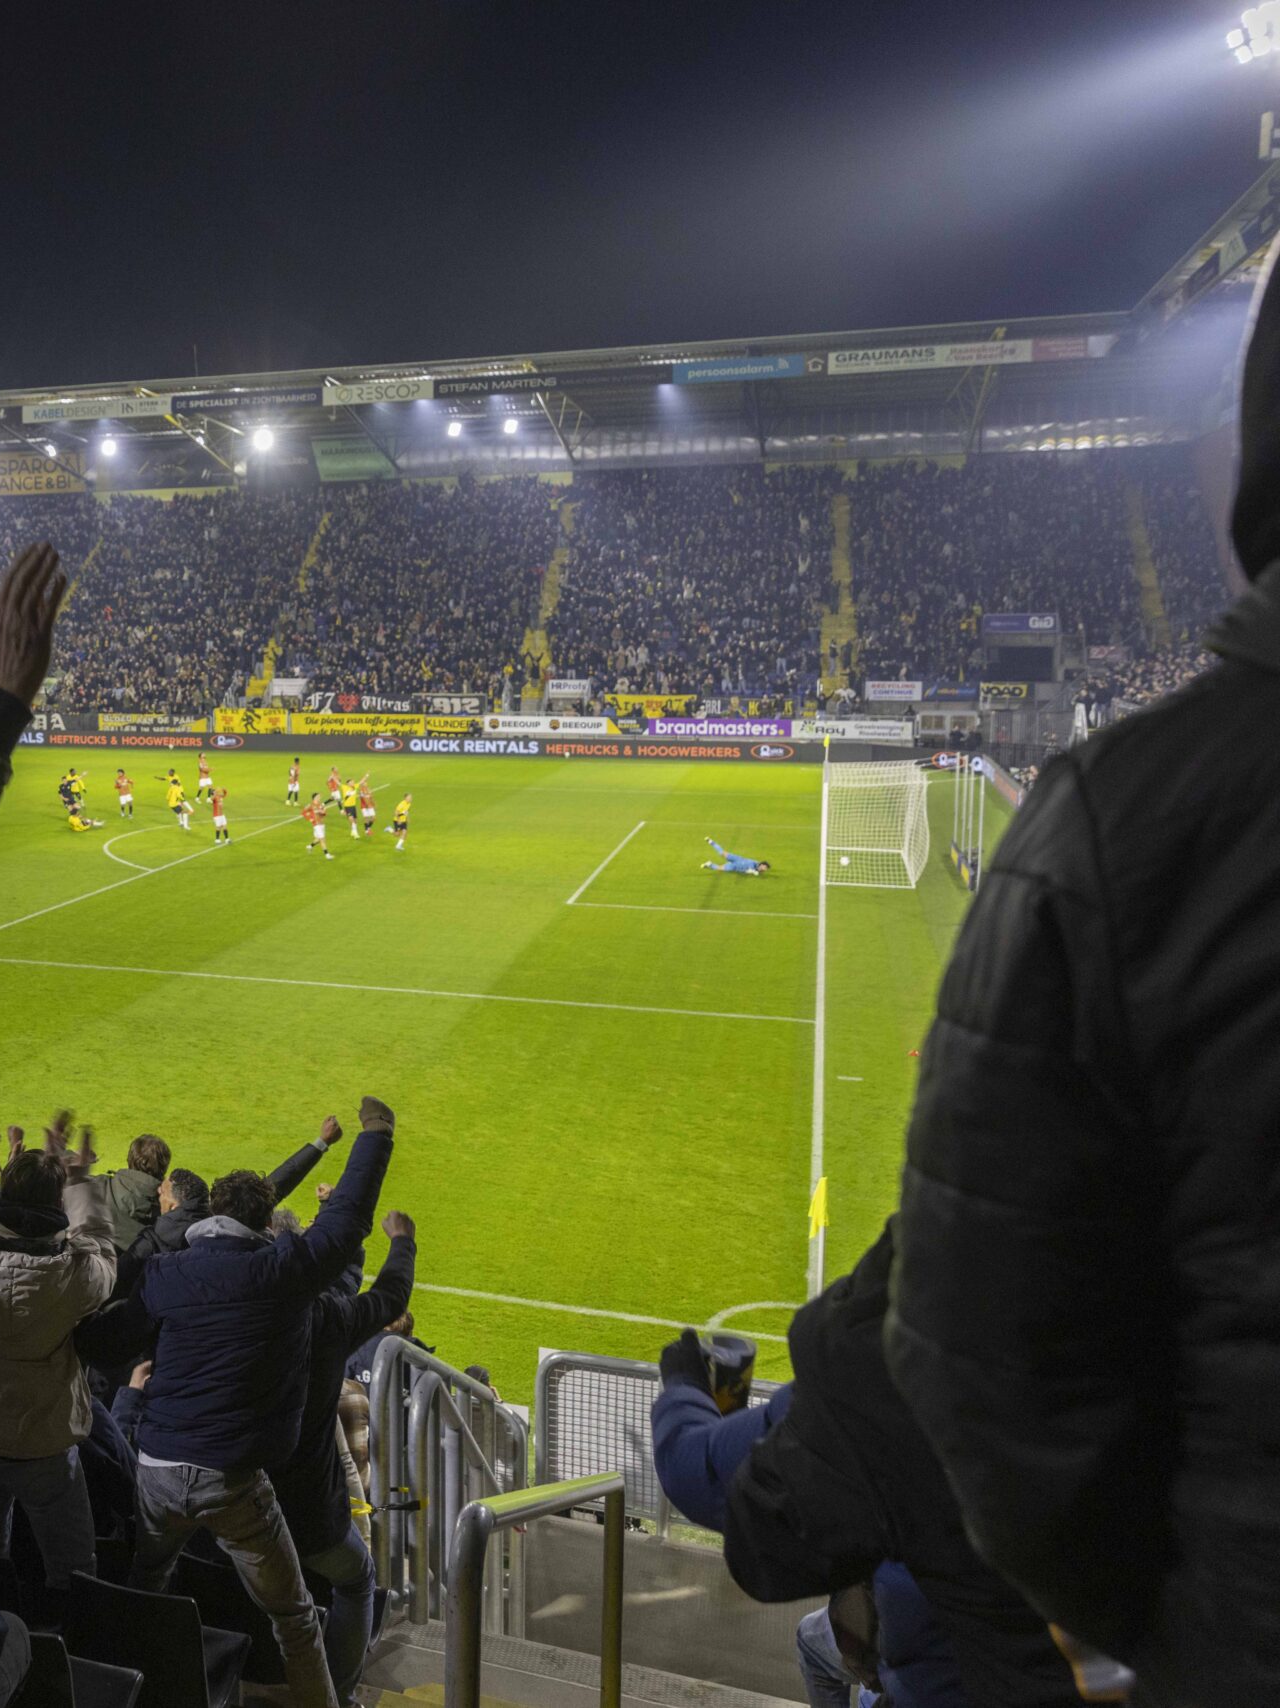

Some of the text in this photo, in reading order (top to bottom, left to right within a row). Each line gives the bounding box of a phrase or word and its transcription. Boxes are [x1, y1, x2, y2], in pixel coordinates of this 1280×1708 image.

[835, 347, 936, 363] GRAUMANS
[356, 383, 421, 401] RESCOP
[439, 382, 489, 394] STEFAN
[491, 376, 557, 391] MARTENS
[189, 398, 238, 409] SPECIALIST
[251, 392, 317, 405] ZICHTBAARHEID
[32, 404, 106, 419] KABELDESIGN
[361, 695, 411, 711] Ultras
[501, 720, 541, 728] BEEQUIP
[561, 721, 603, 729] BEEQUIP
[815, 726, 846, 736] Roy
[49, 734, 107, 745] HEFTRUCKS
[110, 735, 117, 745] &
[122, 735, 203, 747] HOOGWERKERS
[409, 738, 741, 758] QUICK RENTALS HEFTRUCKS & HOOGWERKERS
